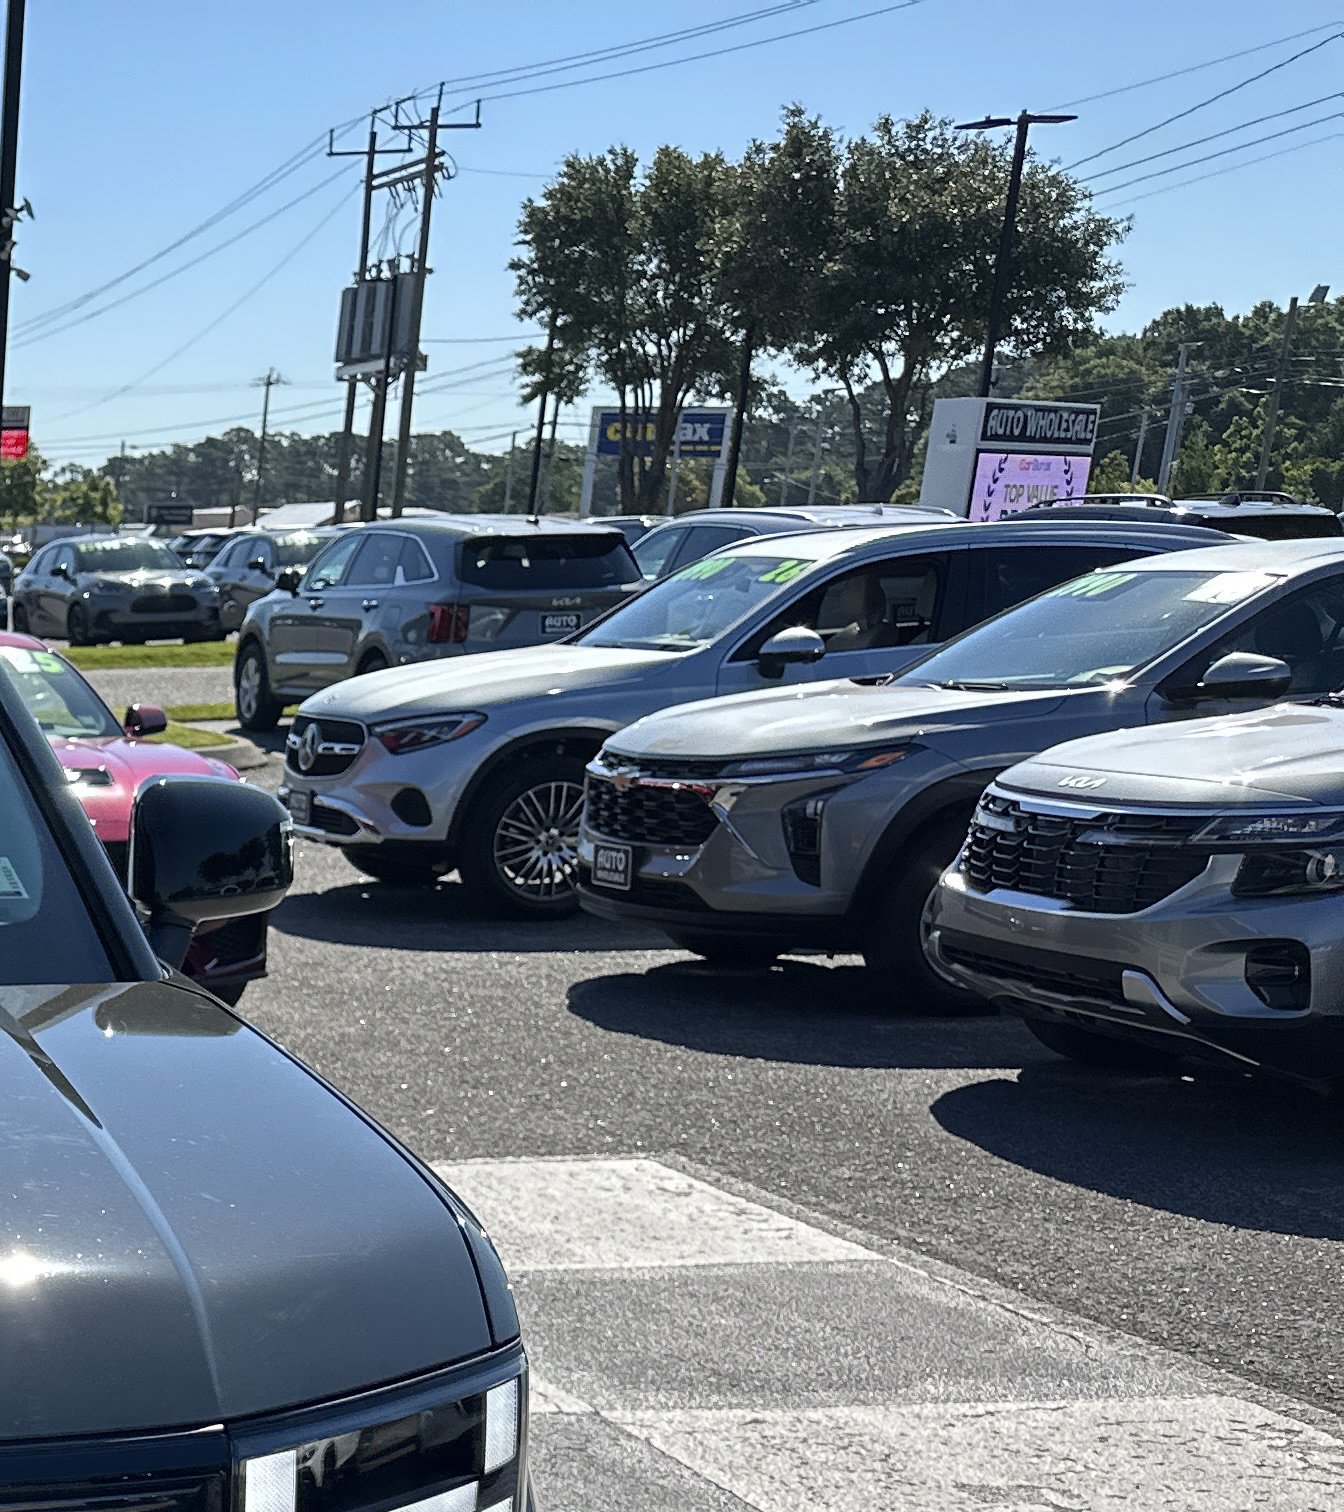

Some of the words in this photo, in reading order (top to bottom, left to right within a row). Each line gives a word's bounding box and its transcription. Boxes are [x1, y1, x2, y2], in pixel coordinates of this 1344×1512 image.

[987, 408, 1024, 437] AUTO
[1026, 410, 1095, 440] WHOLESALE
[1004, 484, 1025, 503] TOP
[545, 615, 578, 627] AUTO
